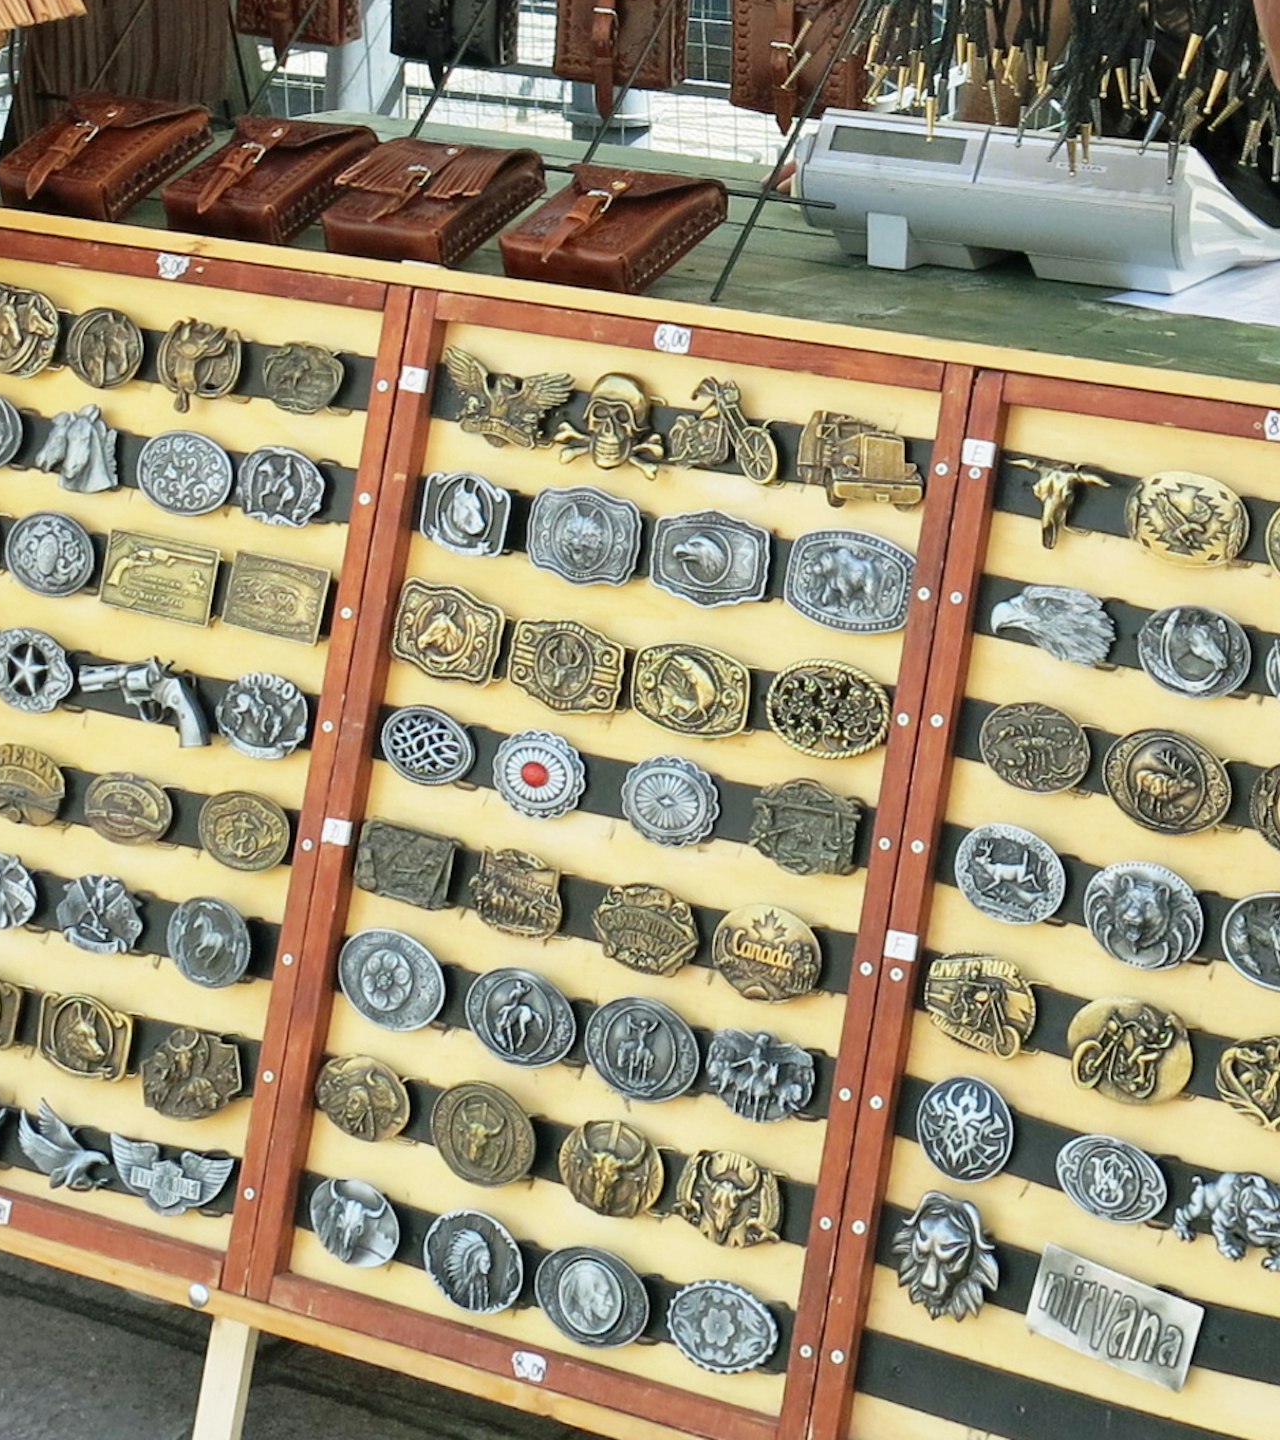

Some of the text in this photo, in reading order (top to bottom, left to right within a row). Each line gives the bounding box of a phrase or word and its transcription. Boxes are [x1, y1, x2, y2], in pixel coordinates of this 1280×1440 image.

[657, 327, 689, 350] 8,00
[970, 444, 985, 463] E
[238, 671, 297, 702] RODEO
[733, 928, 793, 968] Canada
[891, 936, 907, 954] F
[1038, 1264, 1185, 1370] nirvana
